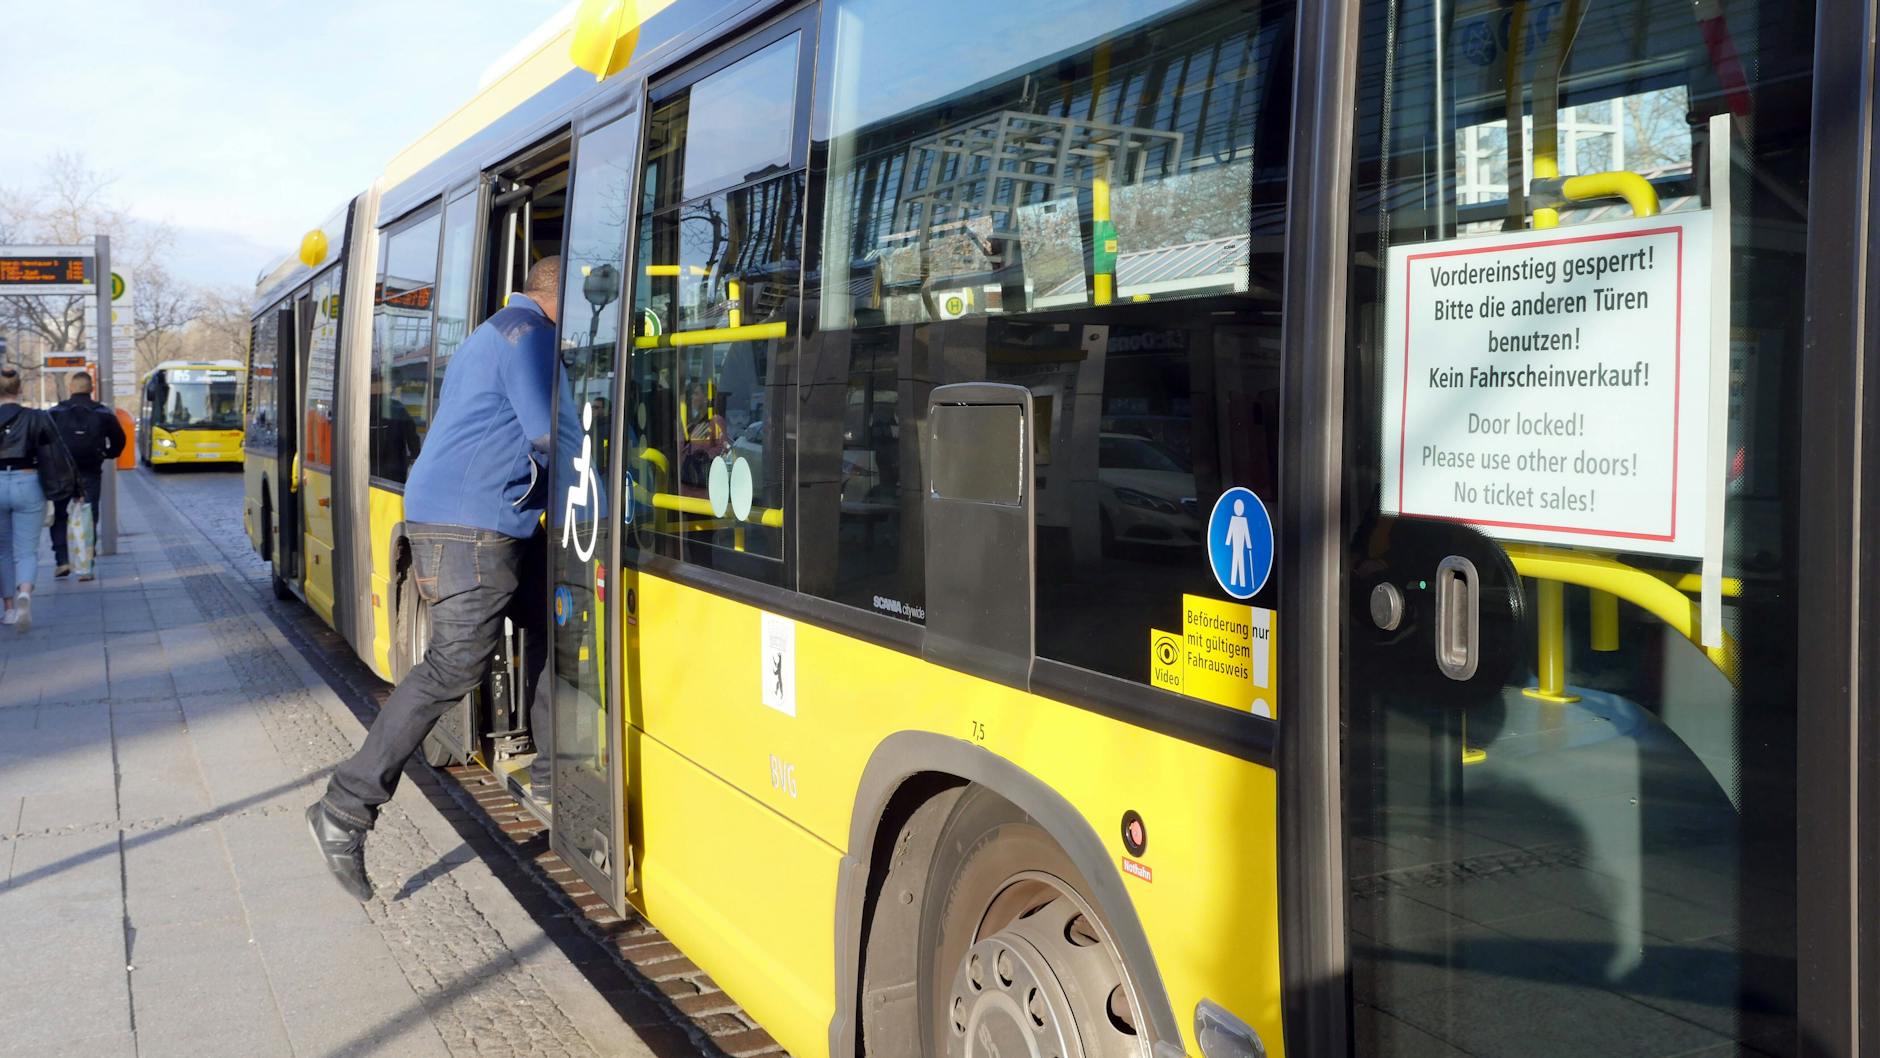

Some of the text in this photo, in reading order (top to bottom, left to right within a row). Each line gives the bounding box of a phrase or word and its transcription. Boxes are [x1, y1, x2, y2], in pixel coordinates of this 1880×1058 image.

[1430, 246, 1654, 287] Vordereinstieg gesperrt!
[1434, 288, 1648, 320] Bitte die anderen Türen
[1488, 327, 1580, 352] benutzen!
[1429, 361, 1648, 388] Kein Fahrscheinverkauf!
[1468, 412, 1584, 436] Door locked!
[1422, 445, 1637, 476] Please use other doors!
[1454, 481, 1594, 512] No ticket sales!
[873, 595, 902, 613] SCANIA
[1187, 610, 1270, 640] Beförderung nur
[1187, 632, 1250, 658] mit gültigem
[1155, 667, 1180, 685] Video
[1187, 652, 1248, 679] Fahrausweis
[972, 720, 985, 741] 7,5
[769, 753, 798, 799] BVG
[1123, 859, 1151, 880] Nothahn
